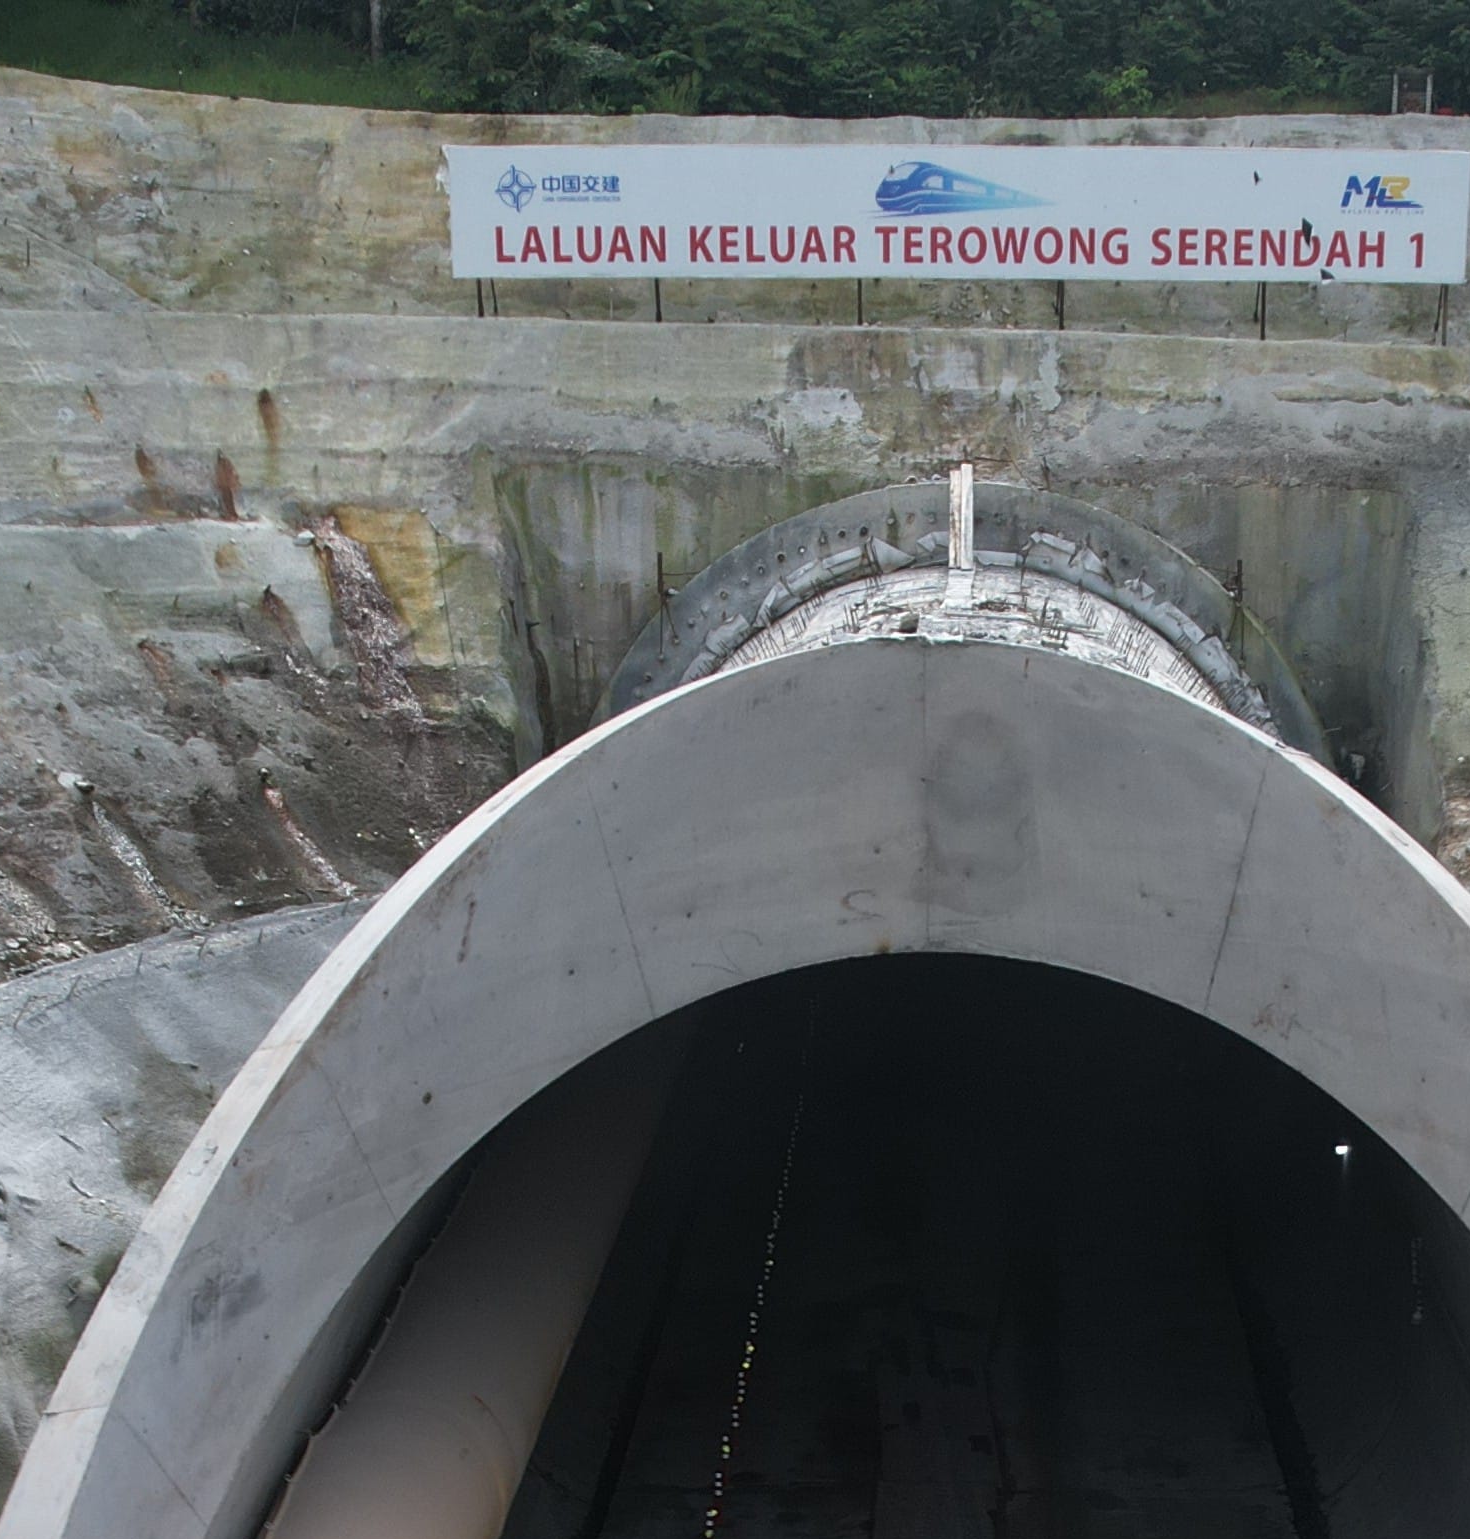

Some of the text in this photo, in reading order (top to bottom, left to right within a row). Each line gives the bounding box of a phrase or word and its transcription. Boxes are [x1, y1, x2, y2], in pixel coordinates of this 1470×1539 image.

[541, 175, 620, 193] 中国交建
[495, 225, 1425, 268] LALUAN KELUAR TEROWONG SERENDAH 1
